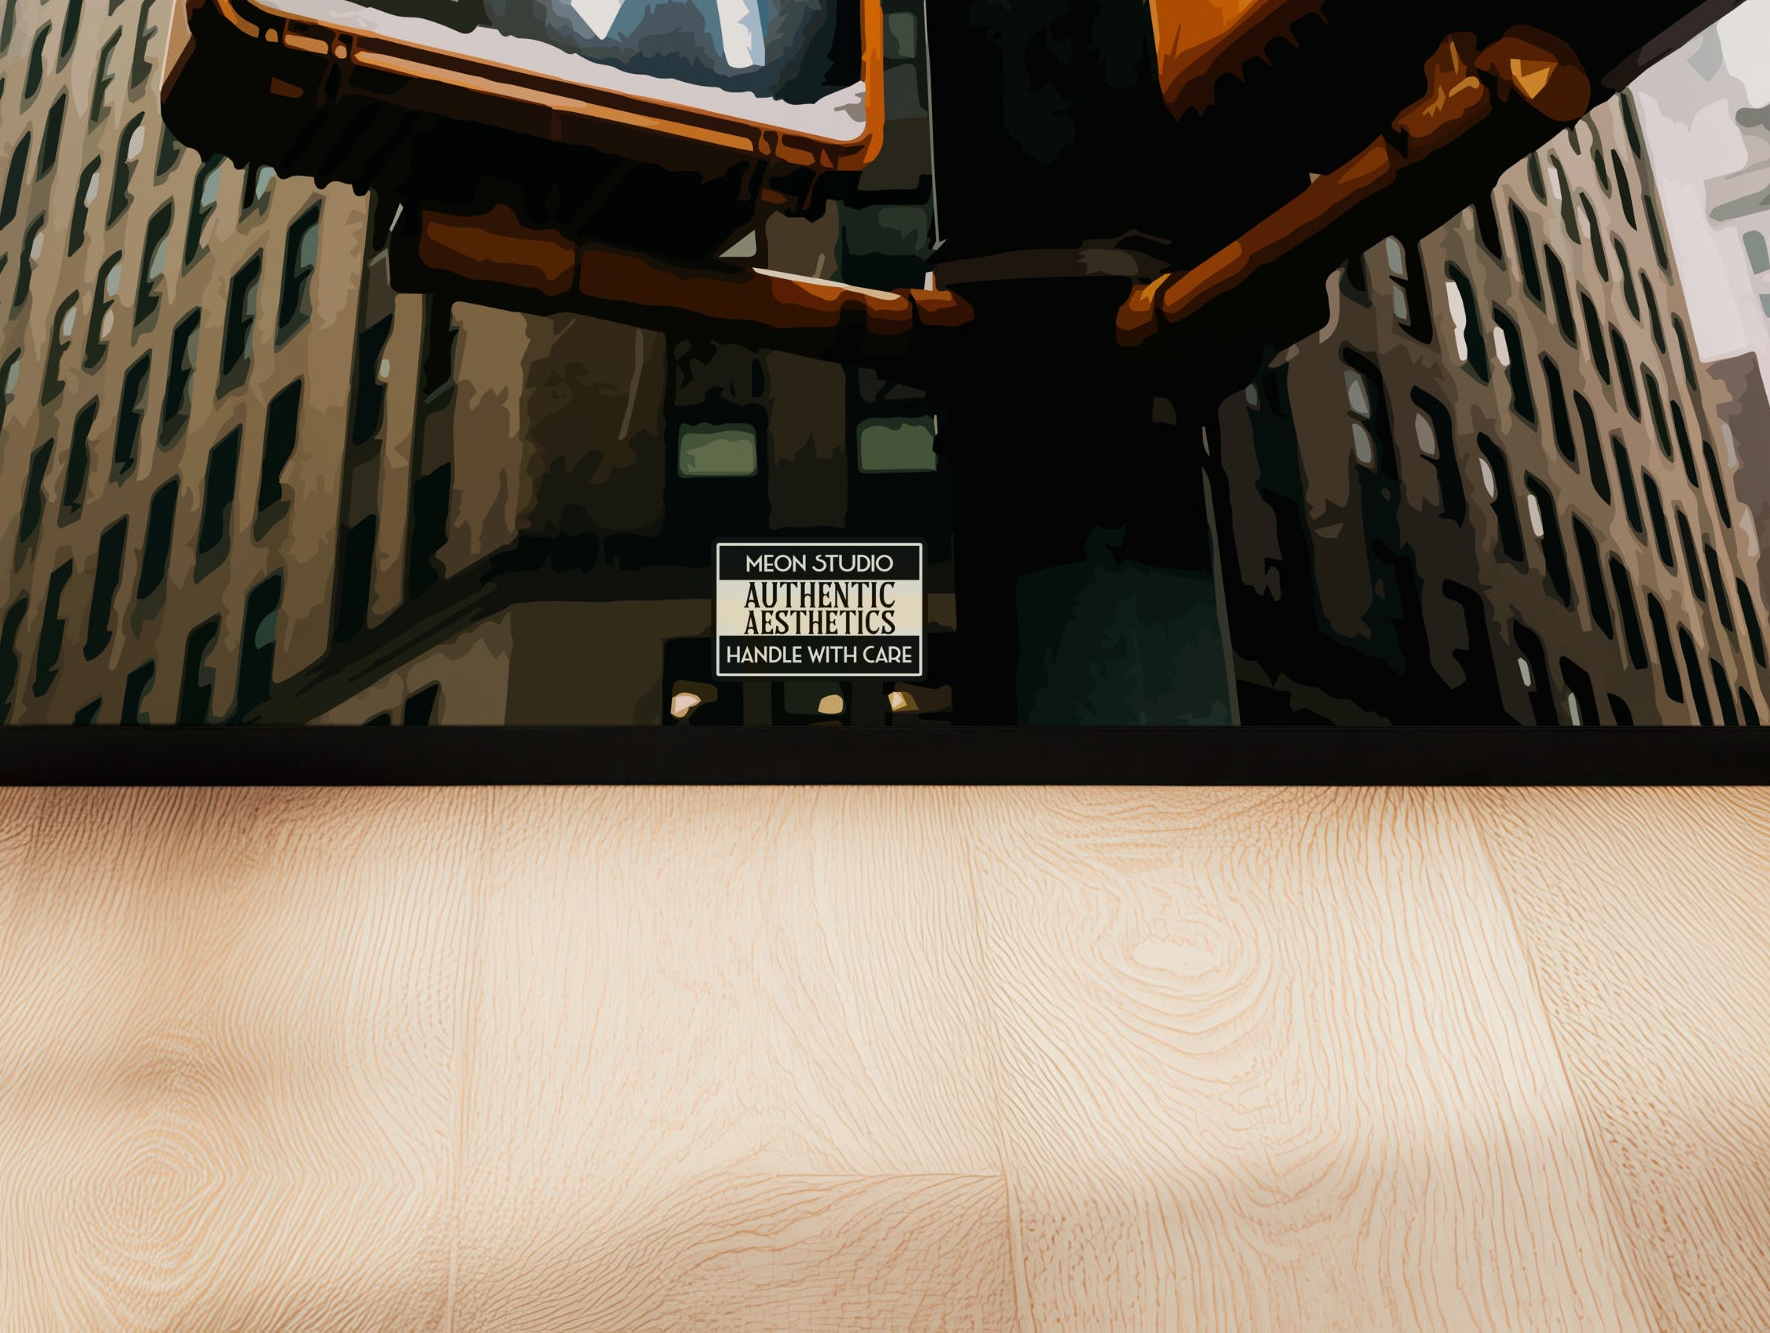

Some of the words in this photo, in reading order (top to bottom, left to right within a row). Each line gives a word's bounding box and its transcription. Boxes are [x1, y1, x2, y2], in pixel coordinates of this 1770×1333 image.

[745, 554, 807, 573] MEON
[811, 554, 894, 573] STUDIO
[744, 581, 896, 609] AUTHENTIC
[744, 609, 896, 635] AESTHETICS
[726, 645, 803, 664] HANDLE
[807, 645, 858, 664] WITH
[862, 645, 913, 664] CARE
